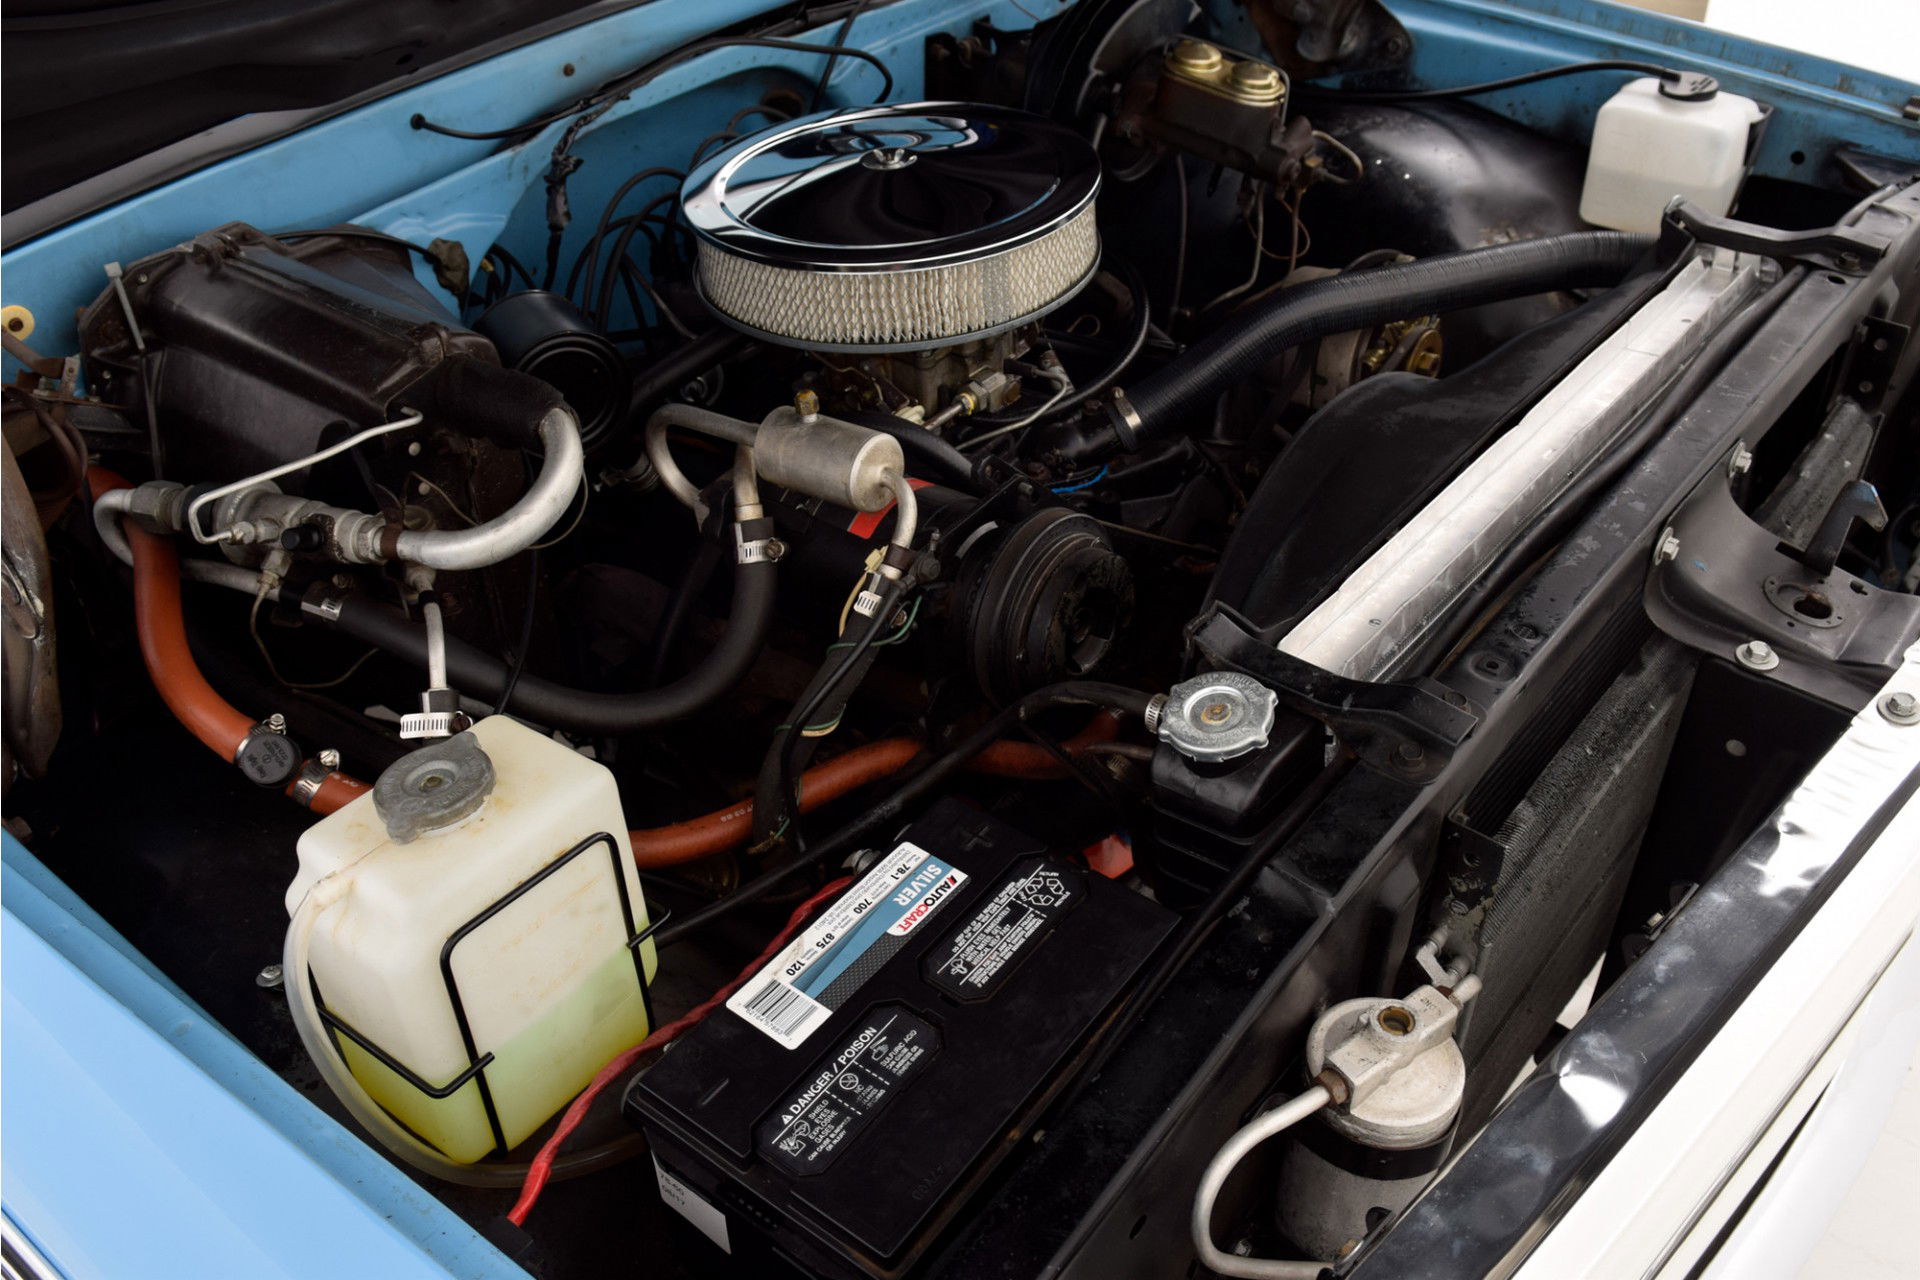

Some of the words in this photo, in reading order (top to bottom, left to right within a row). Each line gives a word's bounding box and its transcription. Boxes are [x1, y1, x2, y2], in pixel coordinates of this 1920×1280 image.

[889, 863, 911, 880] 78-1
[891, 863, 944, 907] SILVER
[852, 898, 872, 914] 700
[896, 880, 953, 931] AUTOCRAFT
[814, 932, 836, 949] 875
[958, 943, 975, 959] FLUSH
[972, 932, 986, 945] EYES
[983, 906, 1011, 934] IMMEDIATELY
[964, 949, 979, 962] WITH
[990, 925, 1002, 935] GET
[970, 945, 991, 965] MEDICAL
[988, 934, 1002, 947] HELP
[998, 923, 1012, 936] FAST
[784, 959, 805, 976] 120
[879, 1041, 905, 1067] SULFURIC
[902, 1028, 918, 1043] ACID
[789, 1068, 834, 1115] DANGER
[829, 1061, 841, 1073] /
[837, 1024, 878, 1066] POISON
[807, 1098, 829, 1120] SHIELD
[813, 1107, 831, 1124] EYES
[807, 1109, 838, 1139] EXPLOSIVE
[813, 1123, 835, 1144] GASES
[807, 1150, 818, 1161] CAN
[815, 1137, 831, 1152] CAUSE
[825, 1143, 834, 1151] OR
